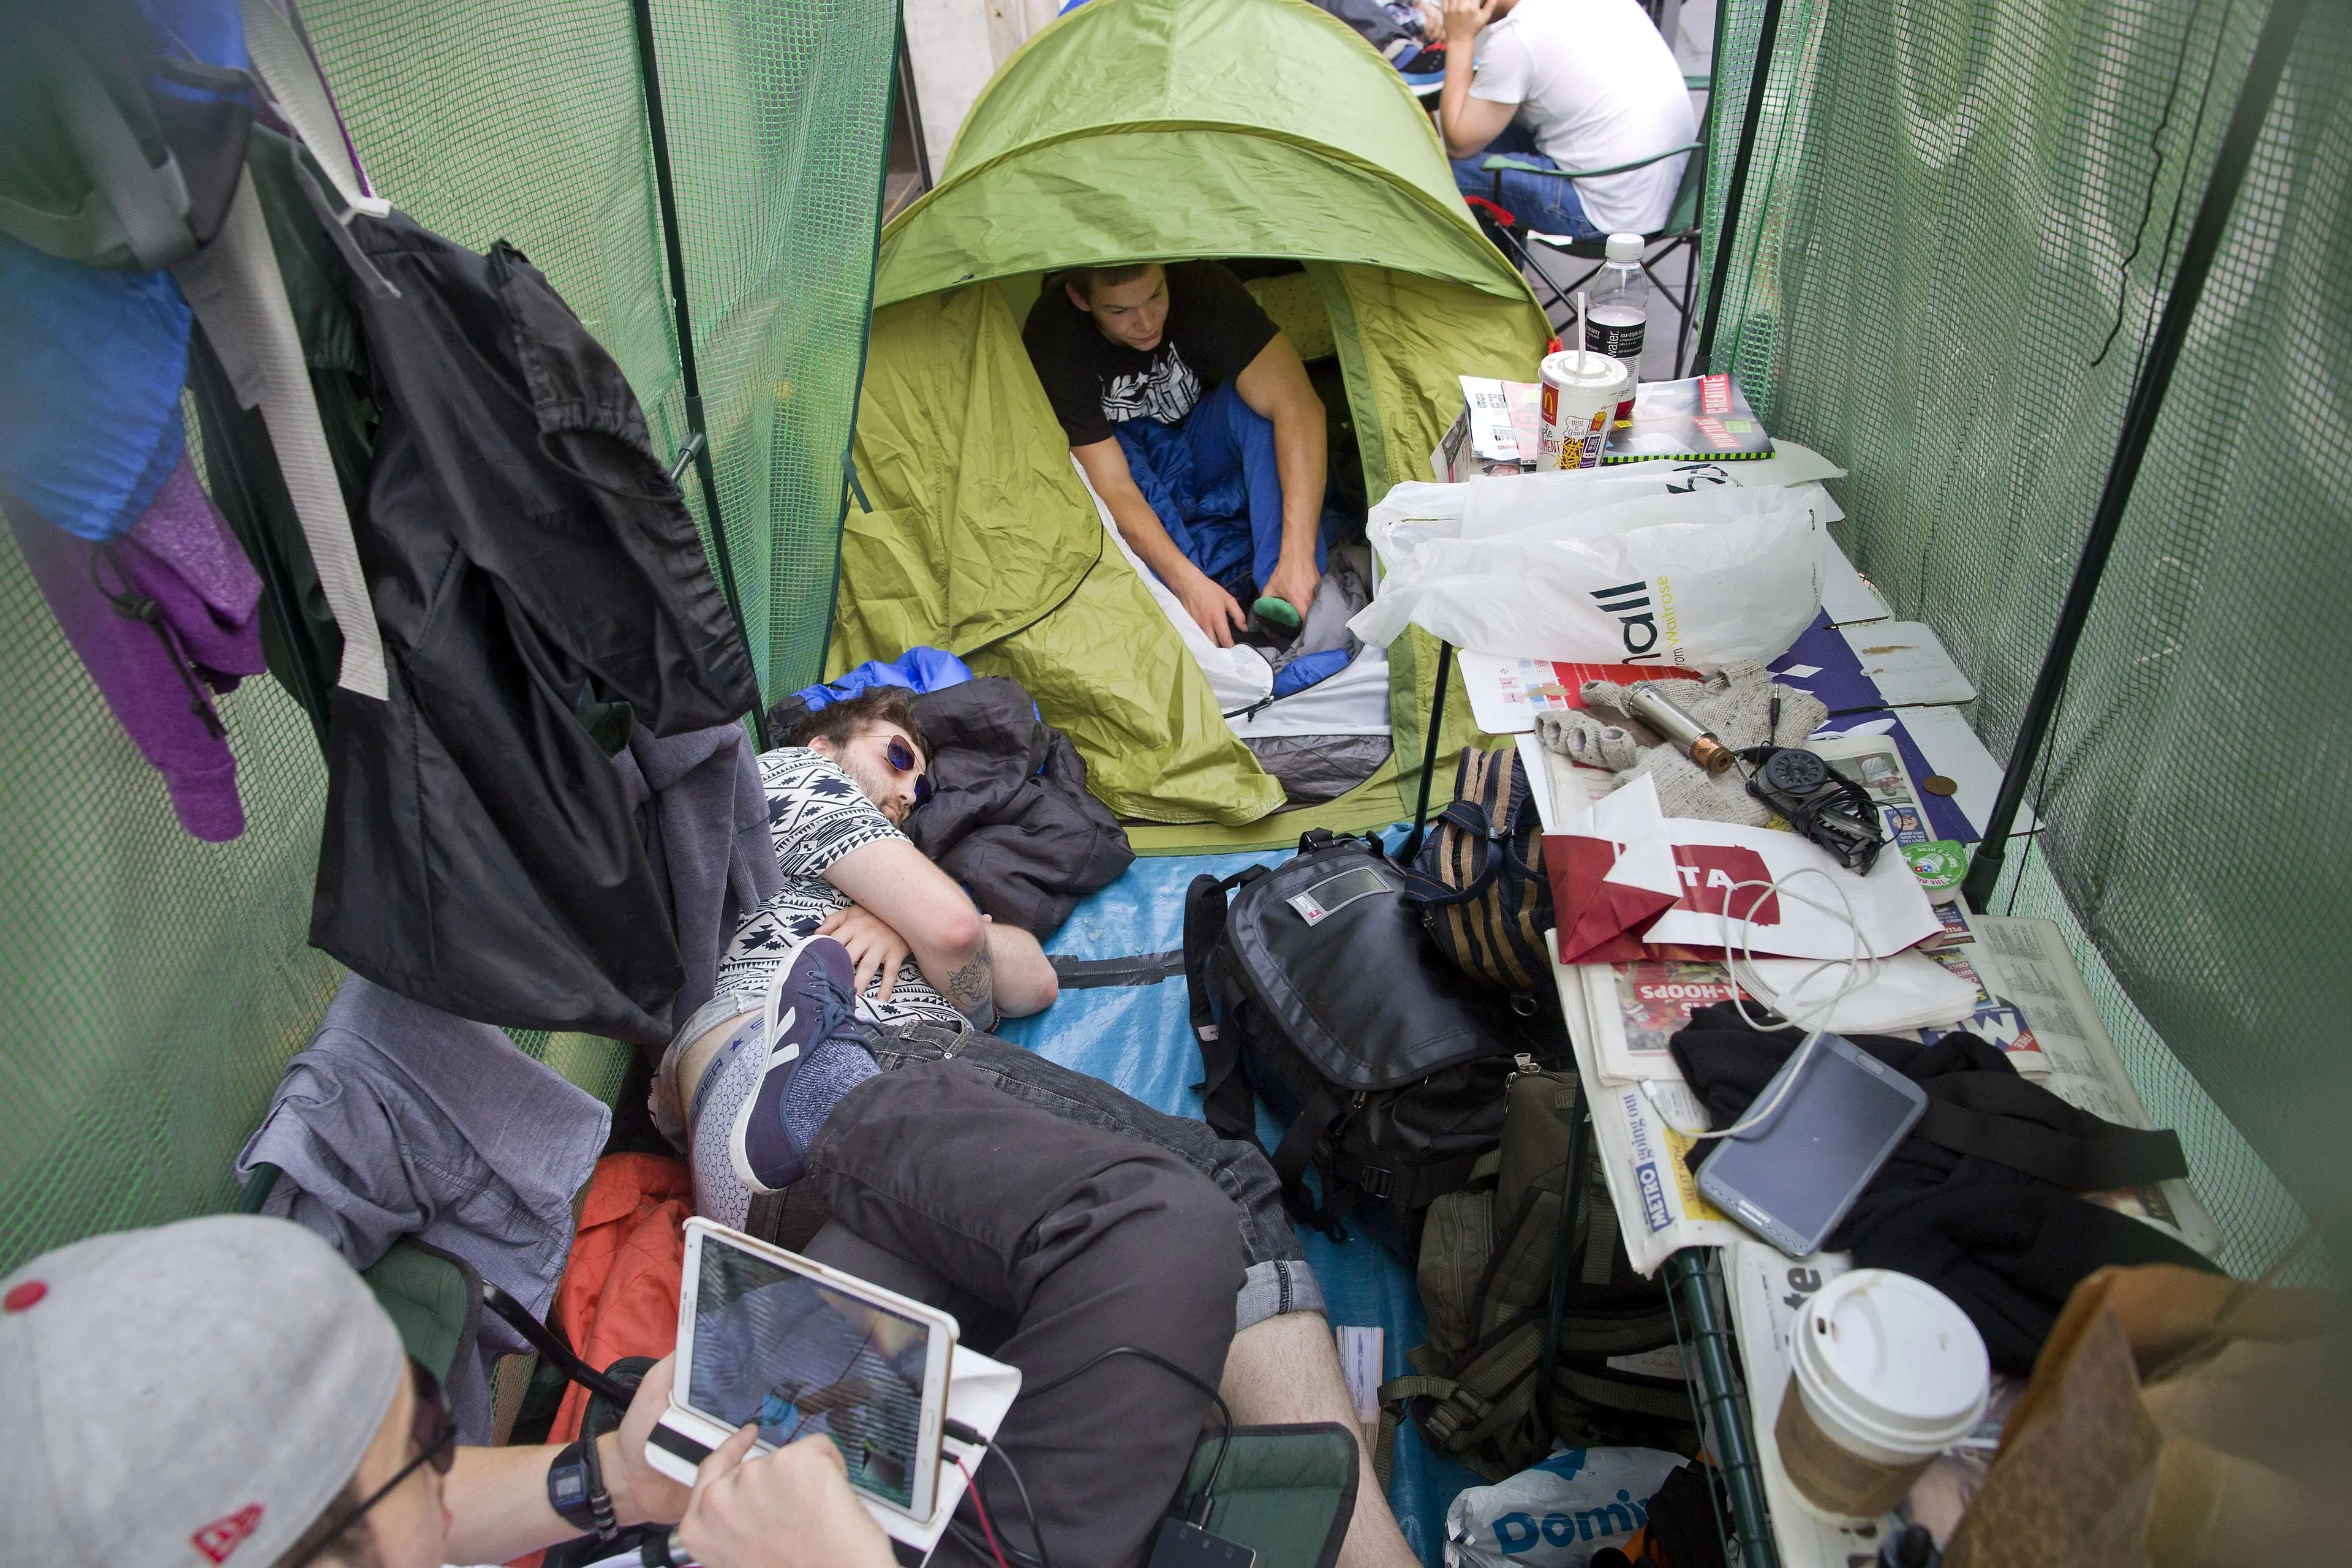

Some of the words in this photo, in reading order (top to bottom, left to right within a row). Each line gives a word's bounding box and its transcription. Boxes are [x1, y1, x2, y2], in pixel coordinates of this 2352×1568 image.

[1703, 376, 1728, 413] CREATIVE
[1703, 425, 1725, 435] TO
[1709, 433, 1737, 448] HOW
[1657, 576, 1680, 649] Waitrose
[1673, 647, 1685, 666] rom
[1942, 851, 1959, 868] GARLIC
[1948, 962, 1969, 970] ONLY
[2013, 1033, 2034, 1050] FREE
[690, 1058, 724, 1130] SUPER
[1629, 1118, 1654, 1161] going
[1679, 1172, 1691, 1183] IT
[1639, 1167, 1669, 1229] METRO
[1493, 1488, 1649, 1555] Domi
